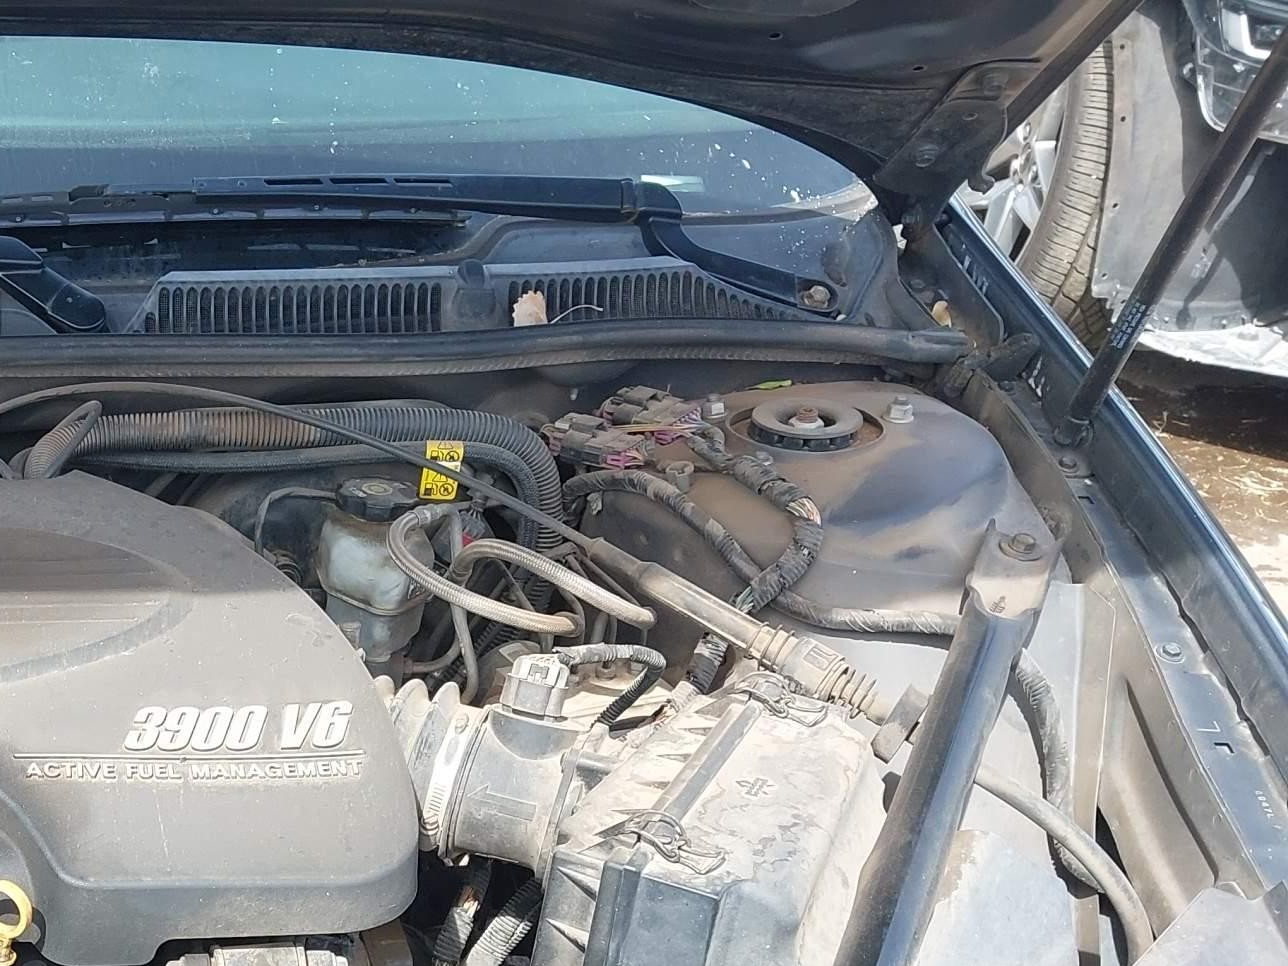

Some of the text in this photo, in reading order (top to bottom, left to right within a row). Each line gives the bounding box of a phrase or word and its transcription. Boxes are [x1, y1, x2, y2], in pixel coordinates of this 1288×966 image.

[123, 700, 353, 752] 3900 V6
[25, 760, 363, 780] ACTIVE FUEL MANAGEMENT
